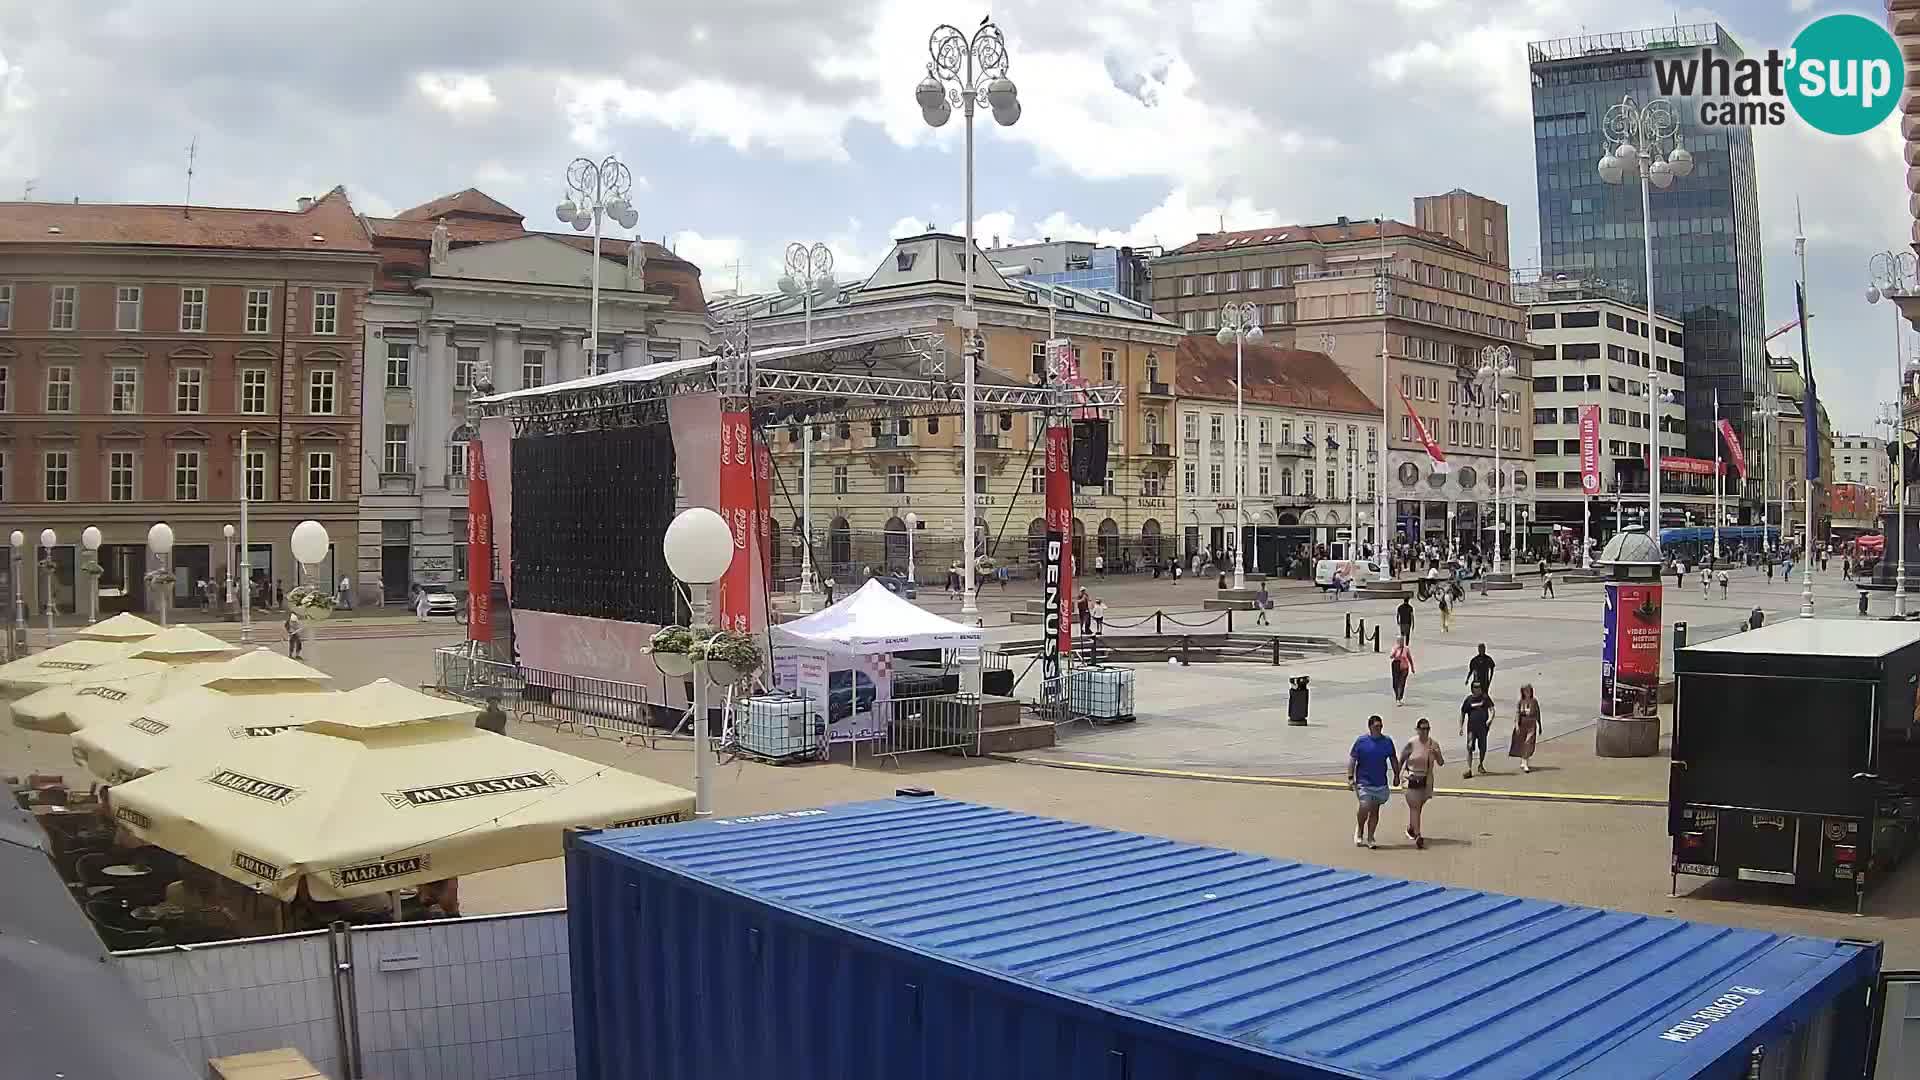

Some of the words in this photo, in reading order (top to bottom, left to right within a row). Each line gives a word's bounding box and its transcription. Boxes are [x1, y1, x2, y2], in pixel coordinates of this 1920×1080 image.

[961, 496, 995, 505] SGER
[217, 771, 286, 802] MARASKA
[416, 775, 542, 803] MARASKA
[237, 855, 276, 881] MARASKA
[343, 860, 418, 883] MARASKA
[1658, 1020, 1710, 1043] MCDU
[1691, 993, 1748, 1022] 300629
